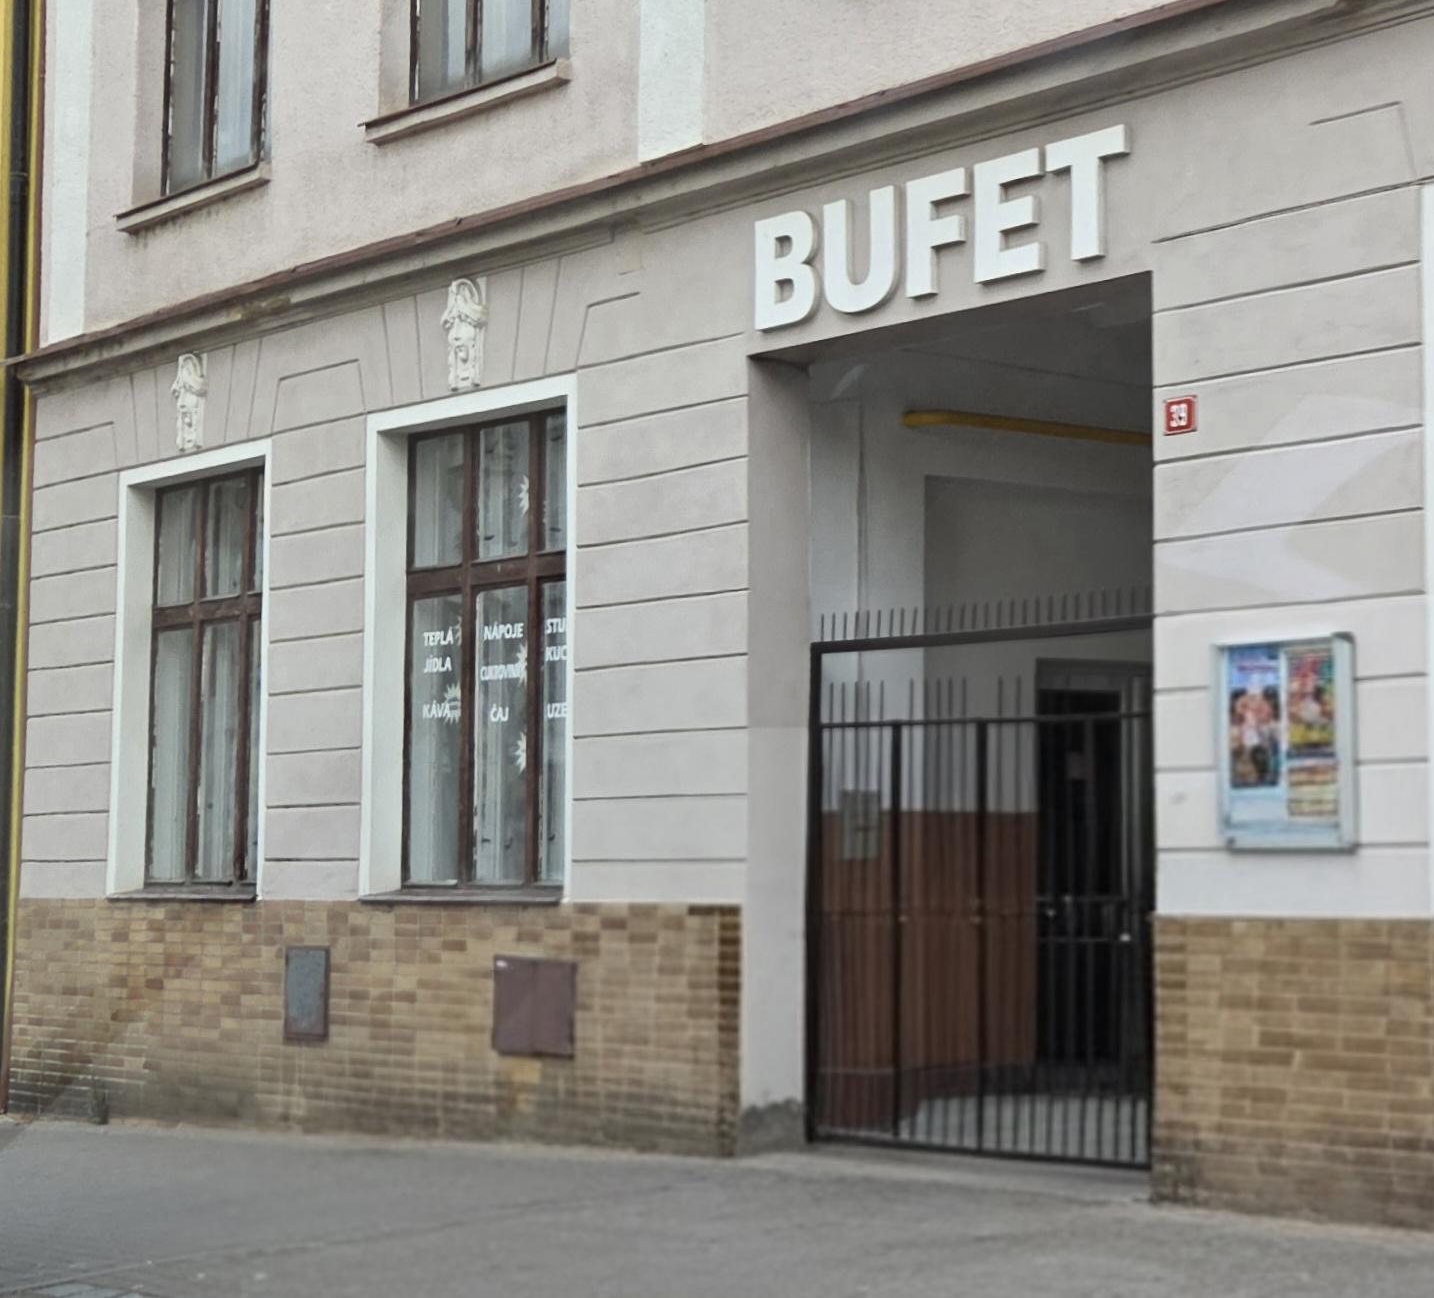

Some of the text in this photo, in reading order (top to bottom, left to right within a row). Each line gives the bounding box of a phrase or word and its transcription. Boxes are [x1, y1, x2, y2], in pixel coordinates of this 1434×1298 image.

[755, 124, 1130, 332] BUFET
[423, 627, 454, 647] TEPLÁ
[484, 622, 524, 640] NÁPOJE
[424, 655, 452, 673] JÍDLA
[422, 699, 450, 719] KÁVA
[490, 703, 509, 722] ČAJ
